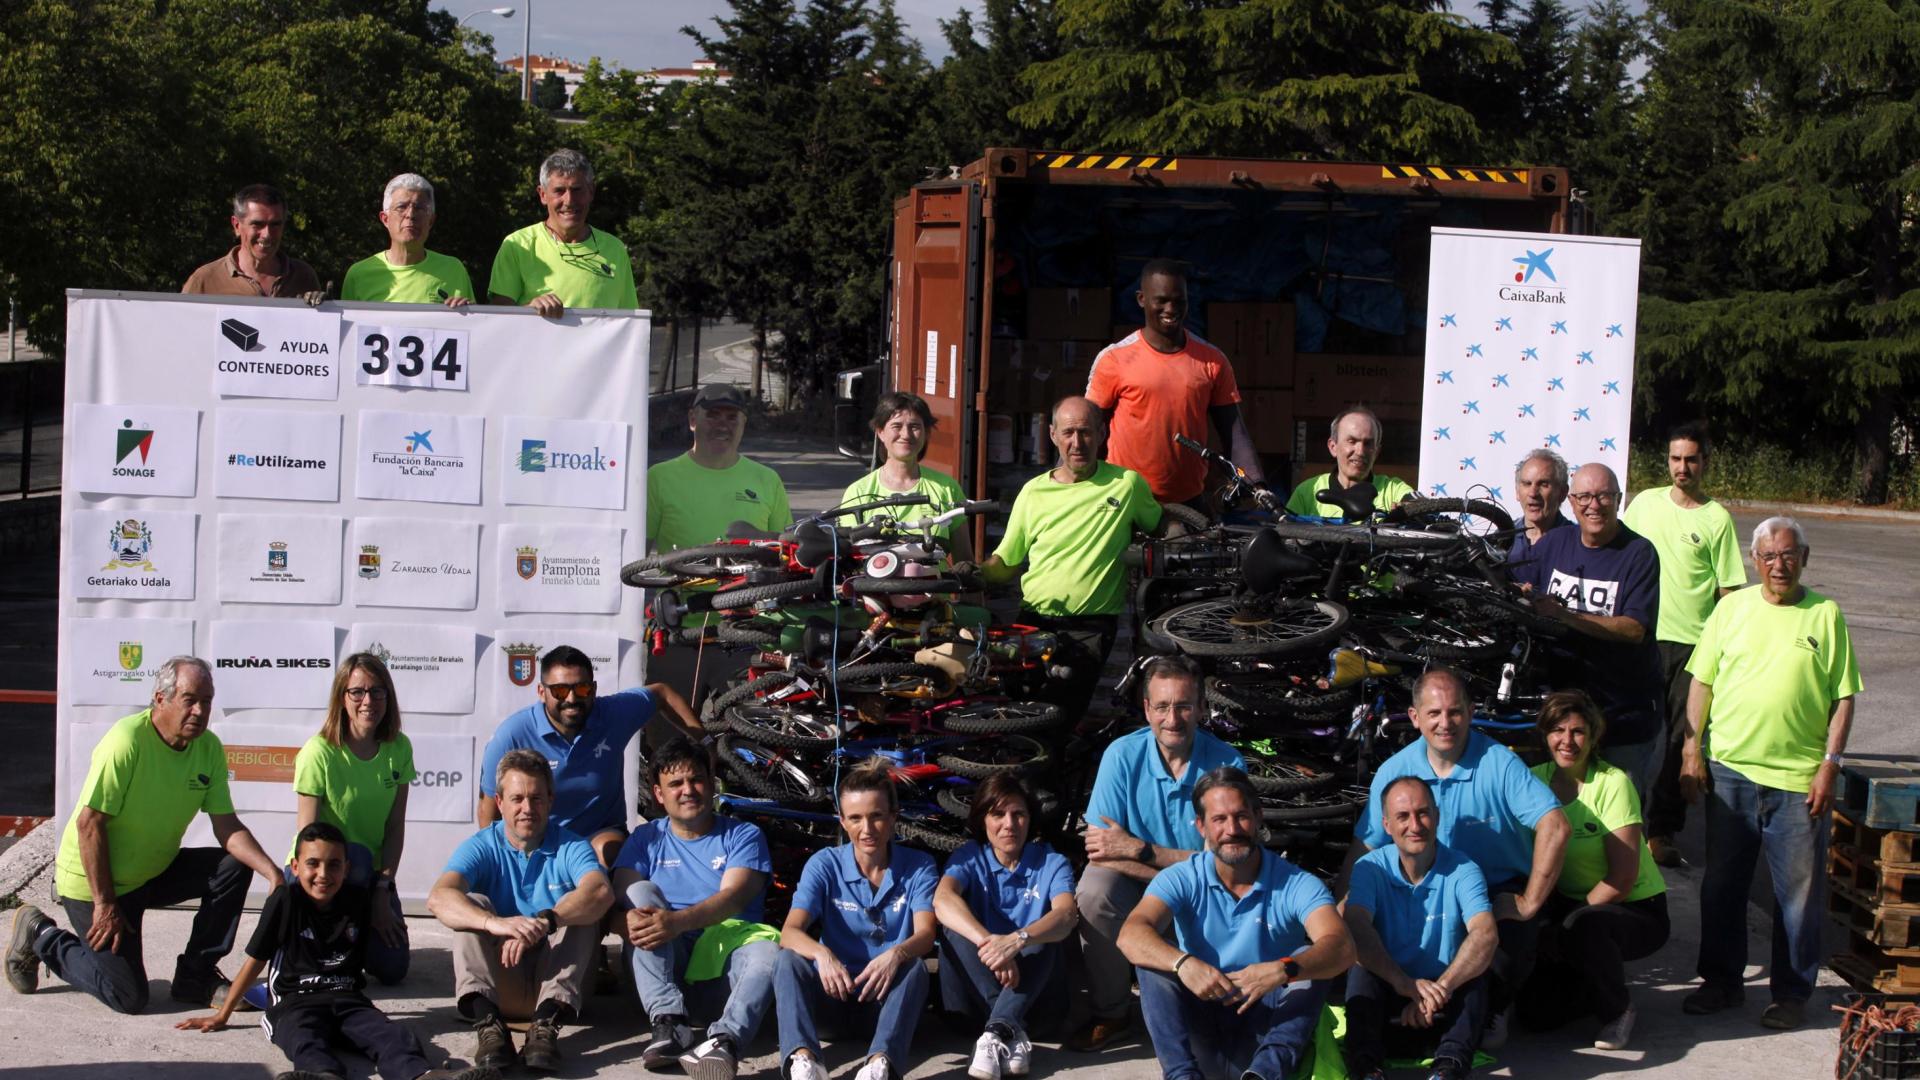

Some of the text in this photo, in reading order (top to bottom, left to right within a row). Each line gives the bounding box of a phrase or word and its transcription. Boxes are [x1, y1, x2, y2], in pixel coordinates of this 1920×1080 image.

[1499, 287, 1566, 304] CaixaBank
[280, 341, 329, 354] AYUDA
[362, 333, 462, 381] 334
[218, 360, 330, 377] CONTENEDORES
[228, 454, 326, 469] #ReUtilízame
[372, 453, 463, 467] Fundación Bancaria
[112, 467, 155, 477] SONAGE
[591, 556, 600, 564] de
[542, 564, 600, 578] Pamplona
[87, 576, 171, 587] Getariako Udala
[216, 656, 331, 668] IRUÑA BIKES
